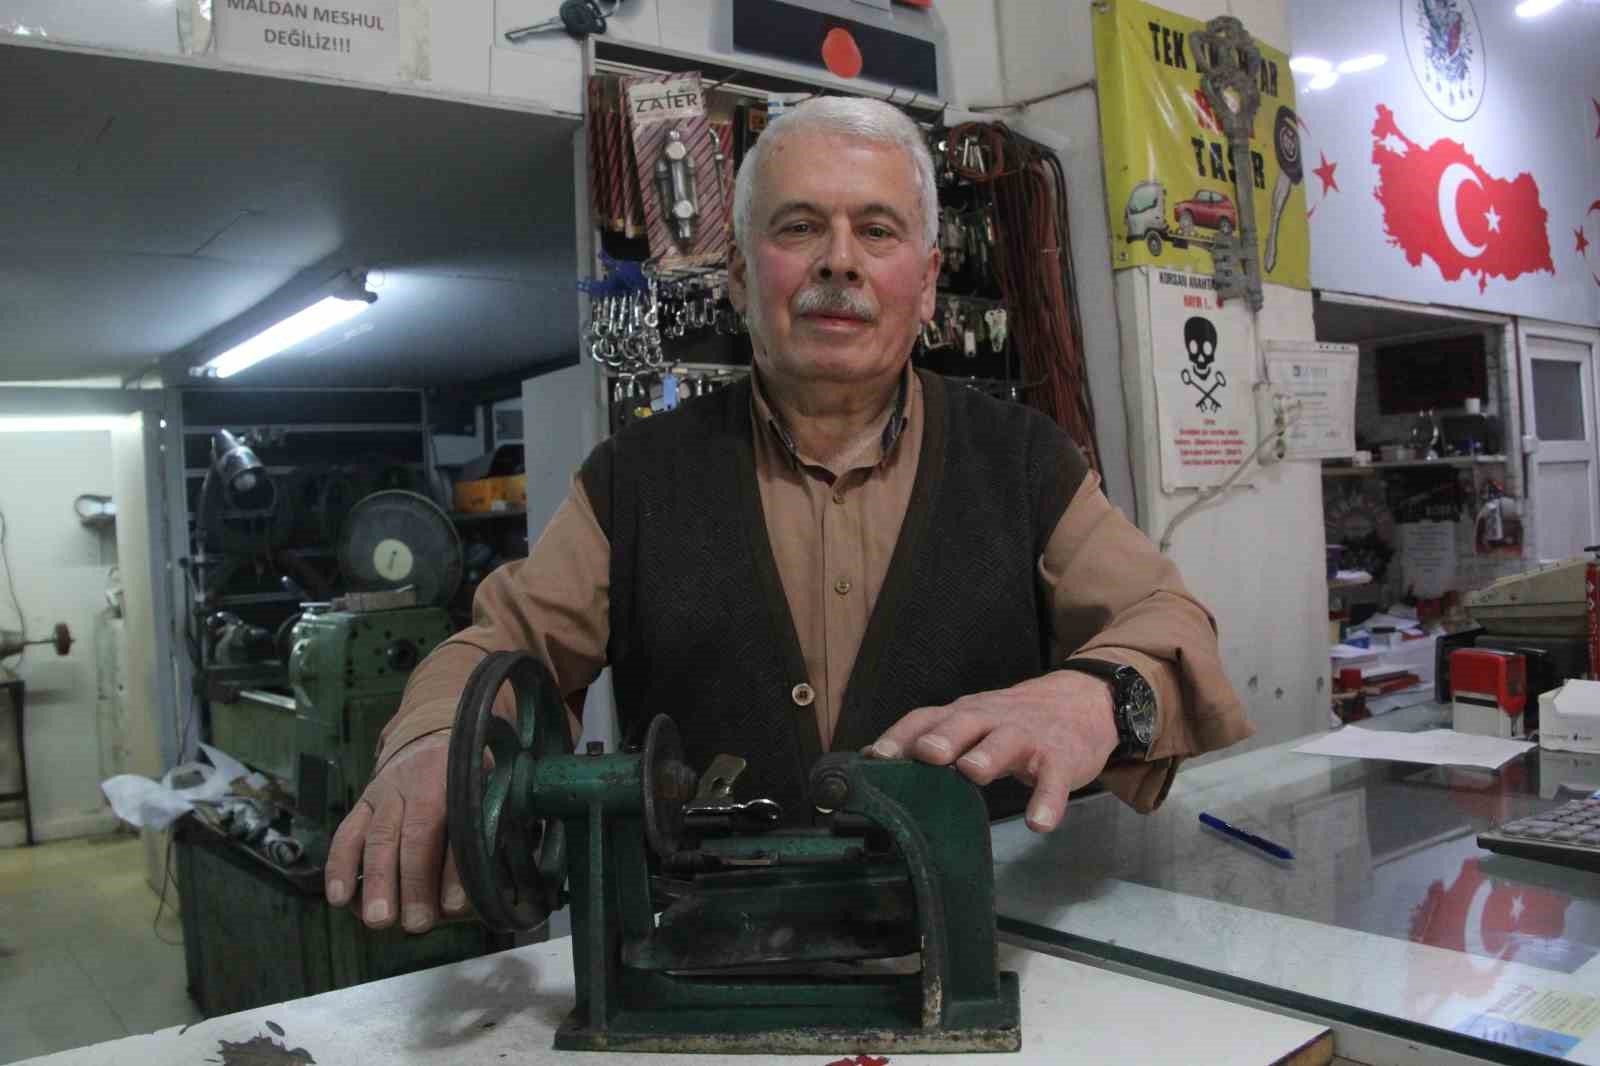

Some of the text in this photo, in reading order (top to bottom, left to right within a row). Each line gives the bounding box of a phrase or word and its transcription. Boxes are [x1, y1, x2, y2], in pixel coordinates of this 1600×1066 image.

[227, 0, 384, 31] MALDAN MESHUL
[263, 28, 351, 53] DEĞİLİZ!!!
[1148, 21, 1188, 70] TEK
